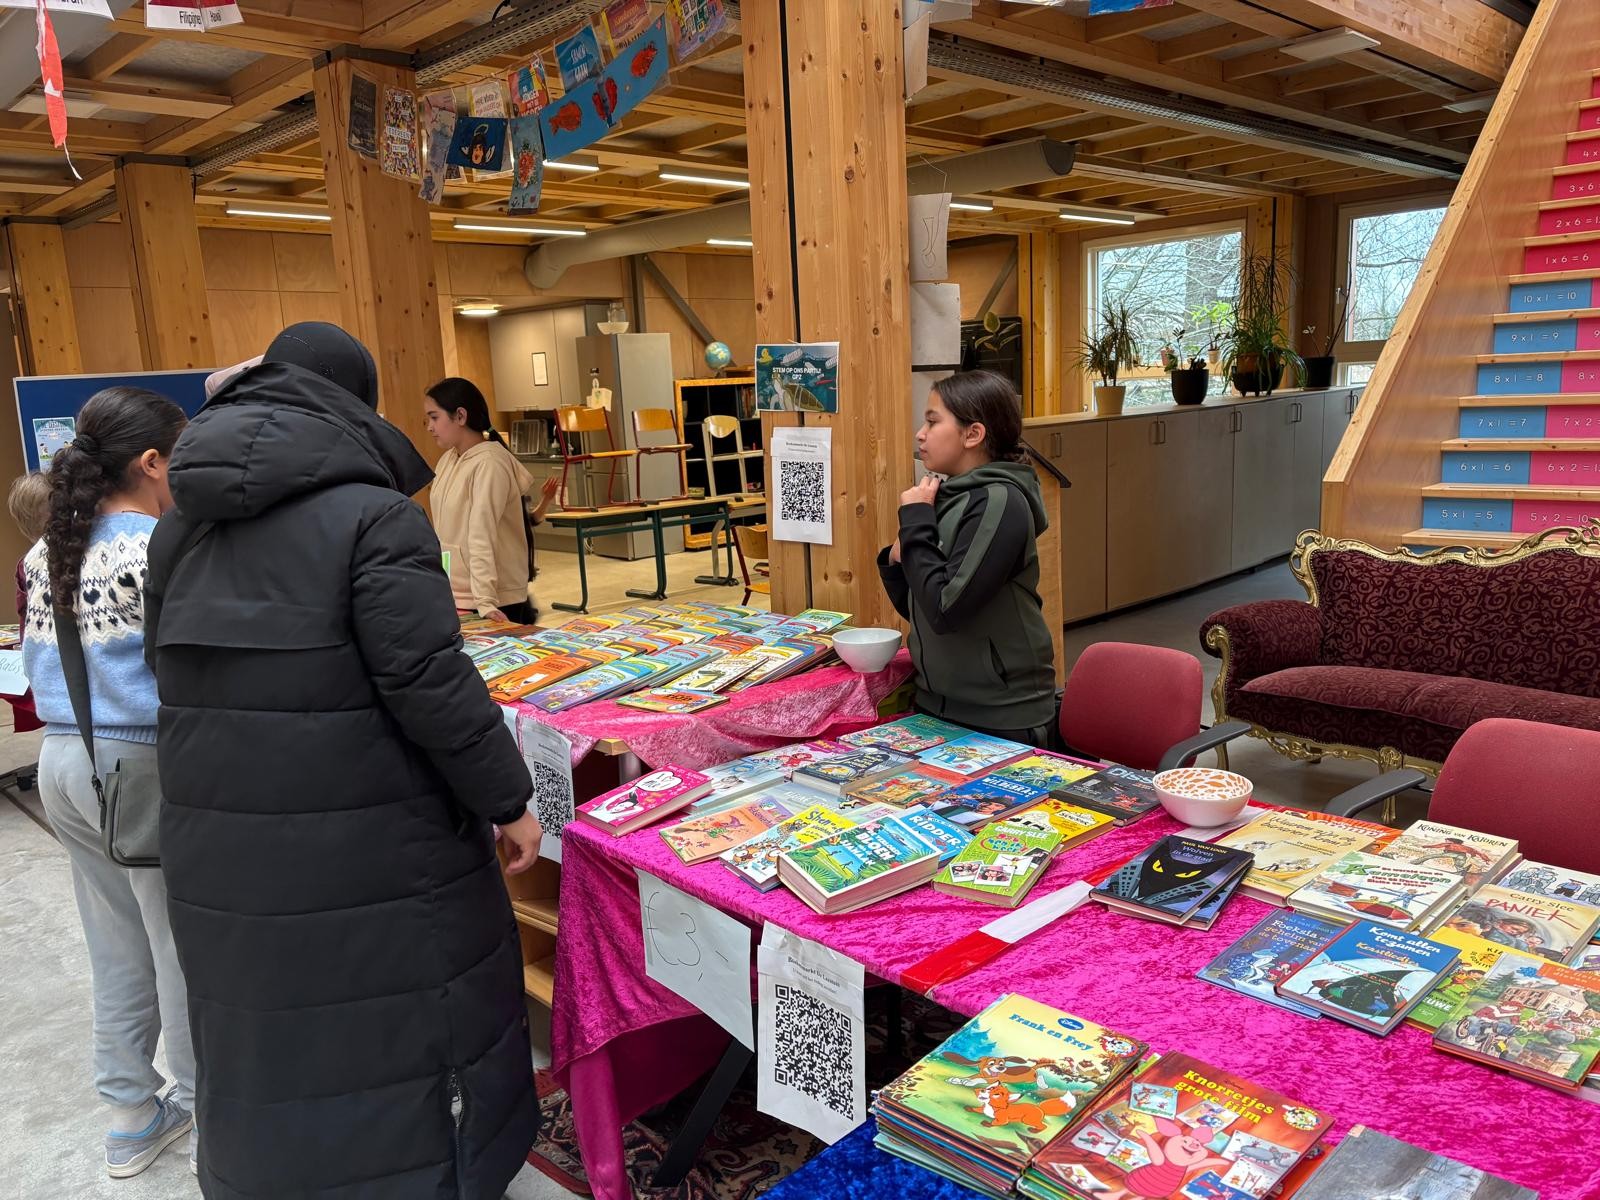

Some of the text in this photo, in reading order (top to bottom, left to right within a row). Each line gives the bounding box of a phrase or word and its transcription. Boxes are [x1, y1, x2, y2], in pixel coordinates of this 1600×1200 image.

[179, 10, 202, 27] Filipijne
[908, 815, 961, 846] RIDDER
[1417, 823, 1452, 835] KONING
[1510, 893, 1574, 912] Carry Slee
[1485, 899, 1581, 931] PANIEK
[1264, 926, 1306, 942] geheim
[1272, 919, 1318, 939] Foeksia
[1374, 936, 1431, 957] tezamen
[1406, 939, 1441, 953] allen
[1008, 1013, 1094, 1051] Frank en Frey
[1173, 1080, 1220, 1104] grote
[1222, 1099, 1262, 1125] film
[1183, 1070, 1275, 1115] Knorretjes
